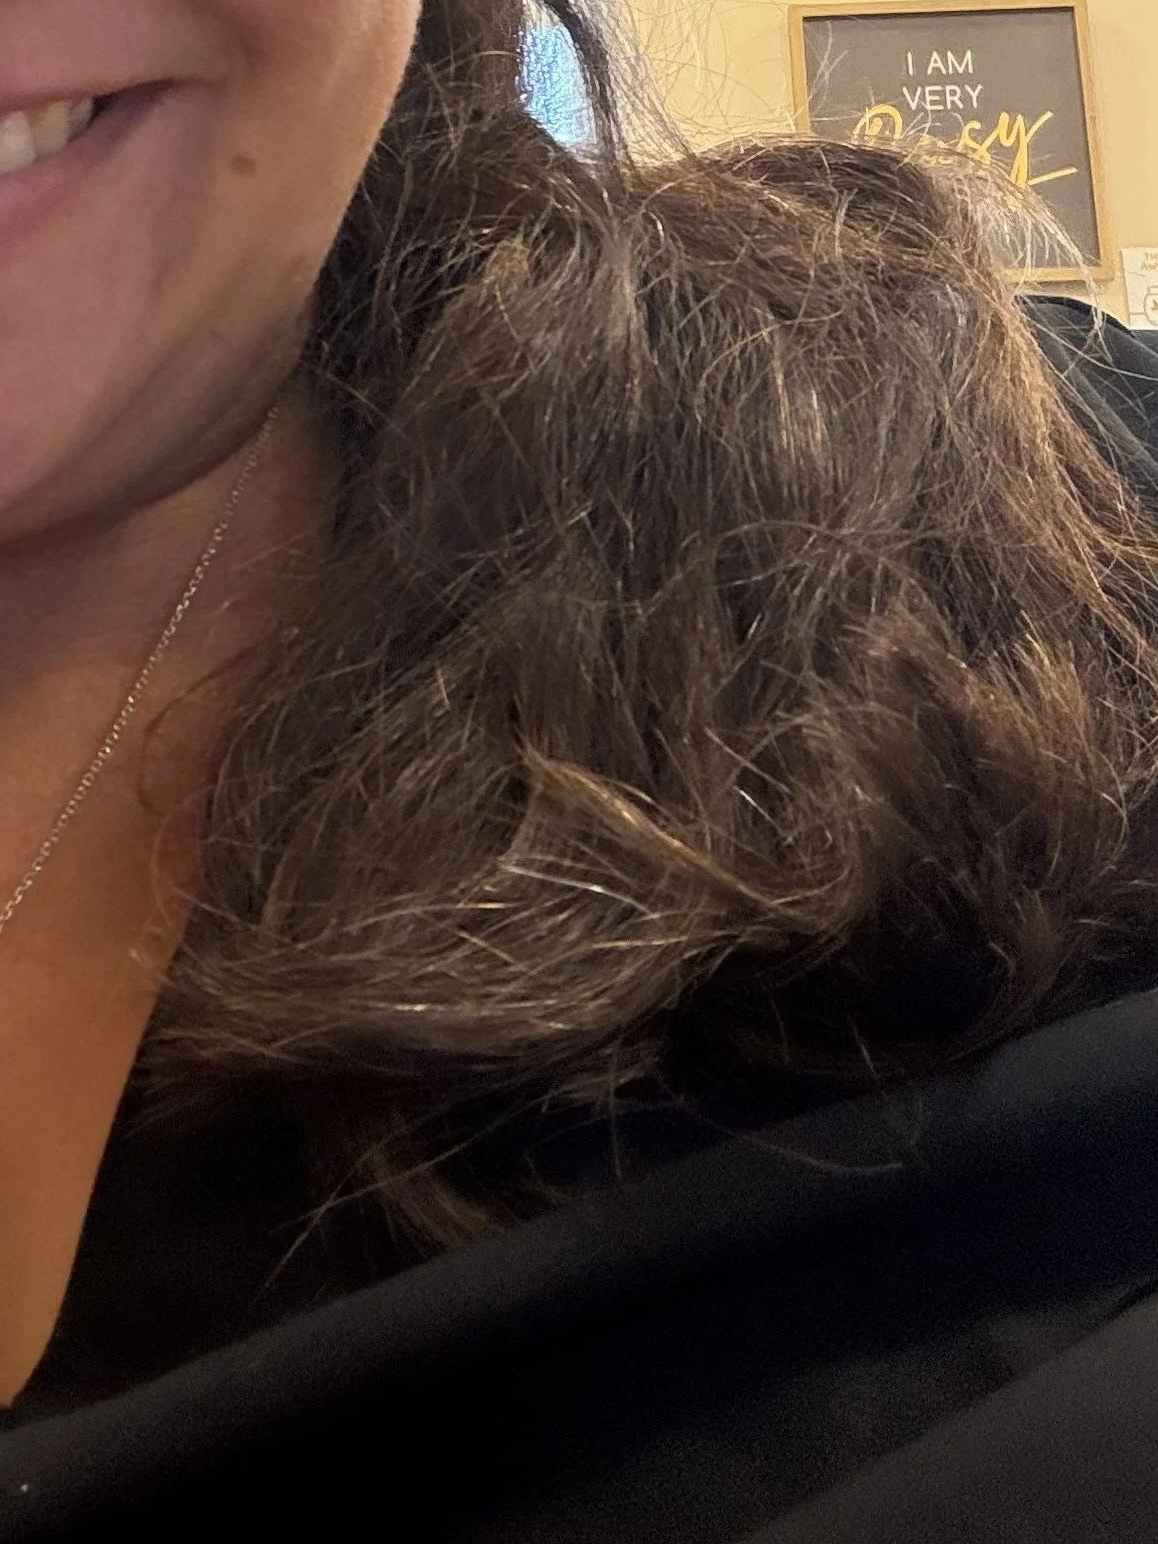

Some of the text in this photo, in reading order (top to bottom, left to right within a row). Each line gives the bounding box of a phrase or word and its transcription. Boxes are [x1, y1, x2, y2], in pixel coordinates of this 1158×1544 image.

[907, 49, 974, 76] I AM
[902, 84, 983, 110] VERY
